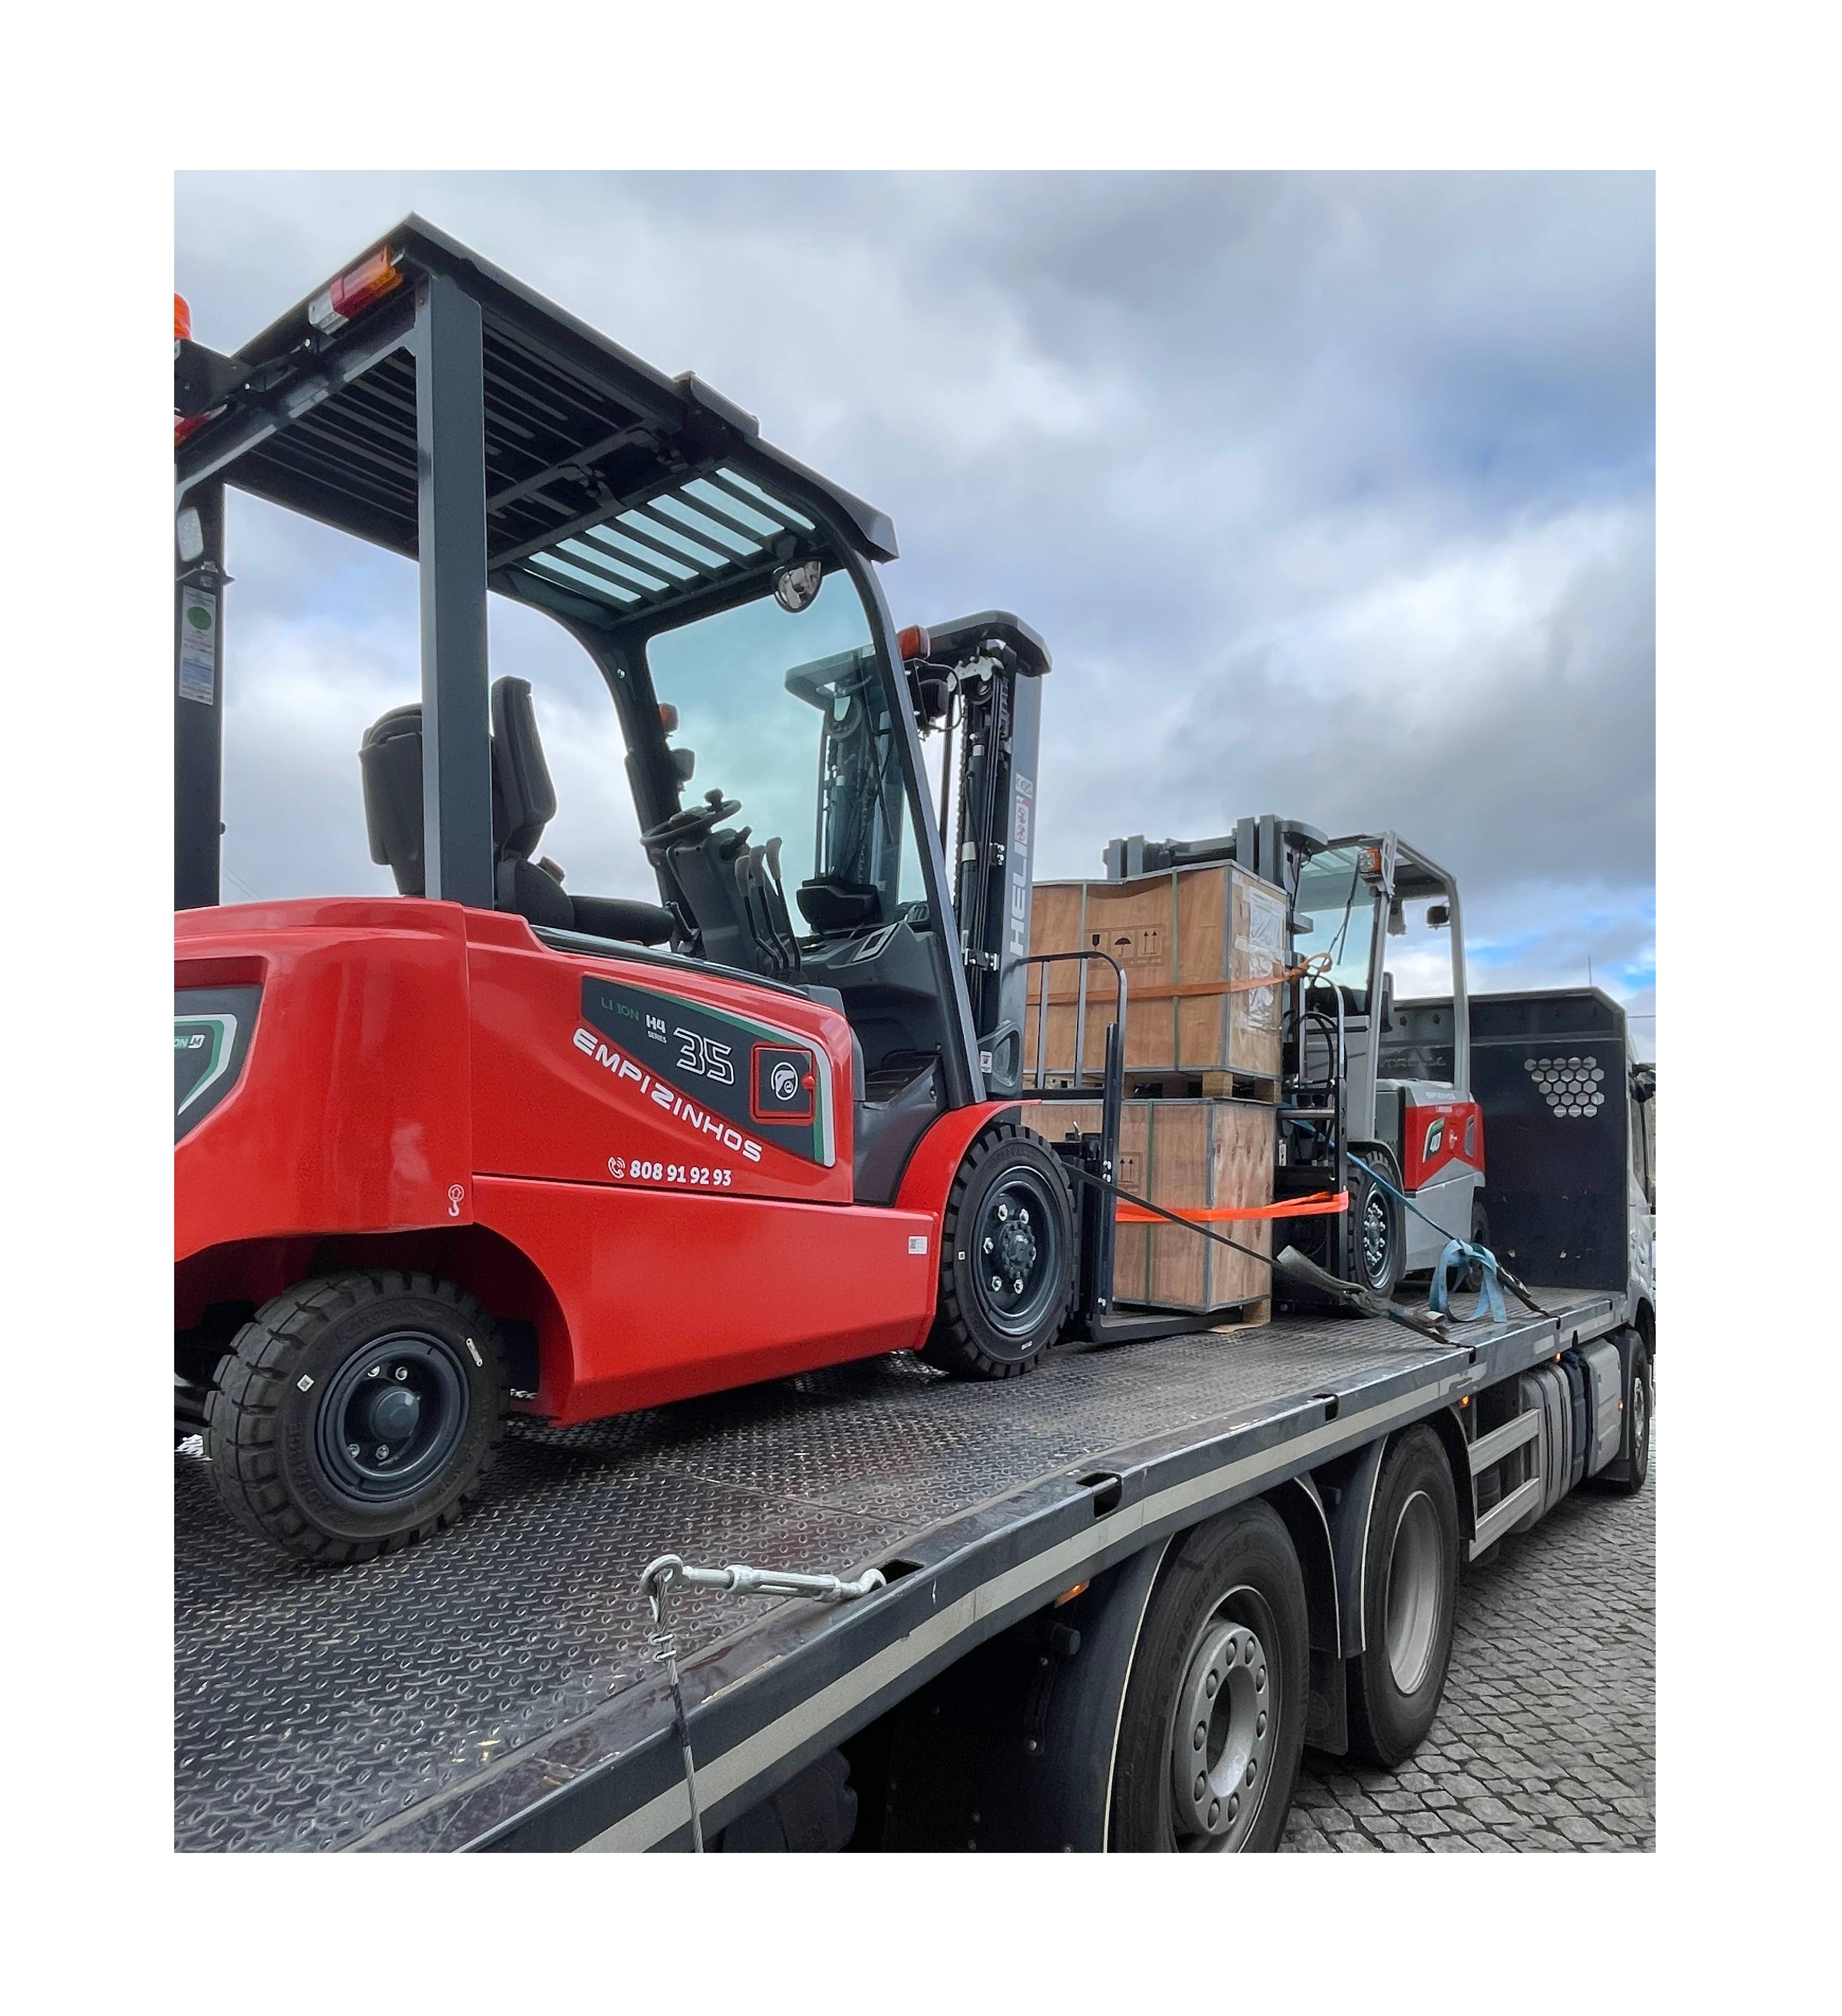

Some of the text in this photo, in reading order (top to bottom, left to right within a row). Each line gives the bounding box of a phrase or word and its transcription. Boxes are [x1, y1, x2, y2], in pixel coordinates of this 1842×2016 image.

[1009, 842, 1028, 957] HELI
[601, 997, 639, 1021] LI ION
[645, 1014, 666, 1034] H4
[647, 1030, 667, 1044] SERIES
[673, 1027, 735, 1085] 35
[573, 1028, 762, 1163] EMPIZINHOS
[630, 1160, 732, 1186] 808 91 92 93
